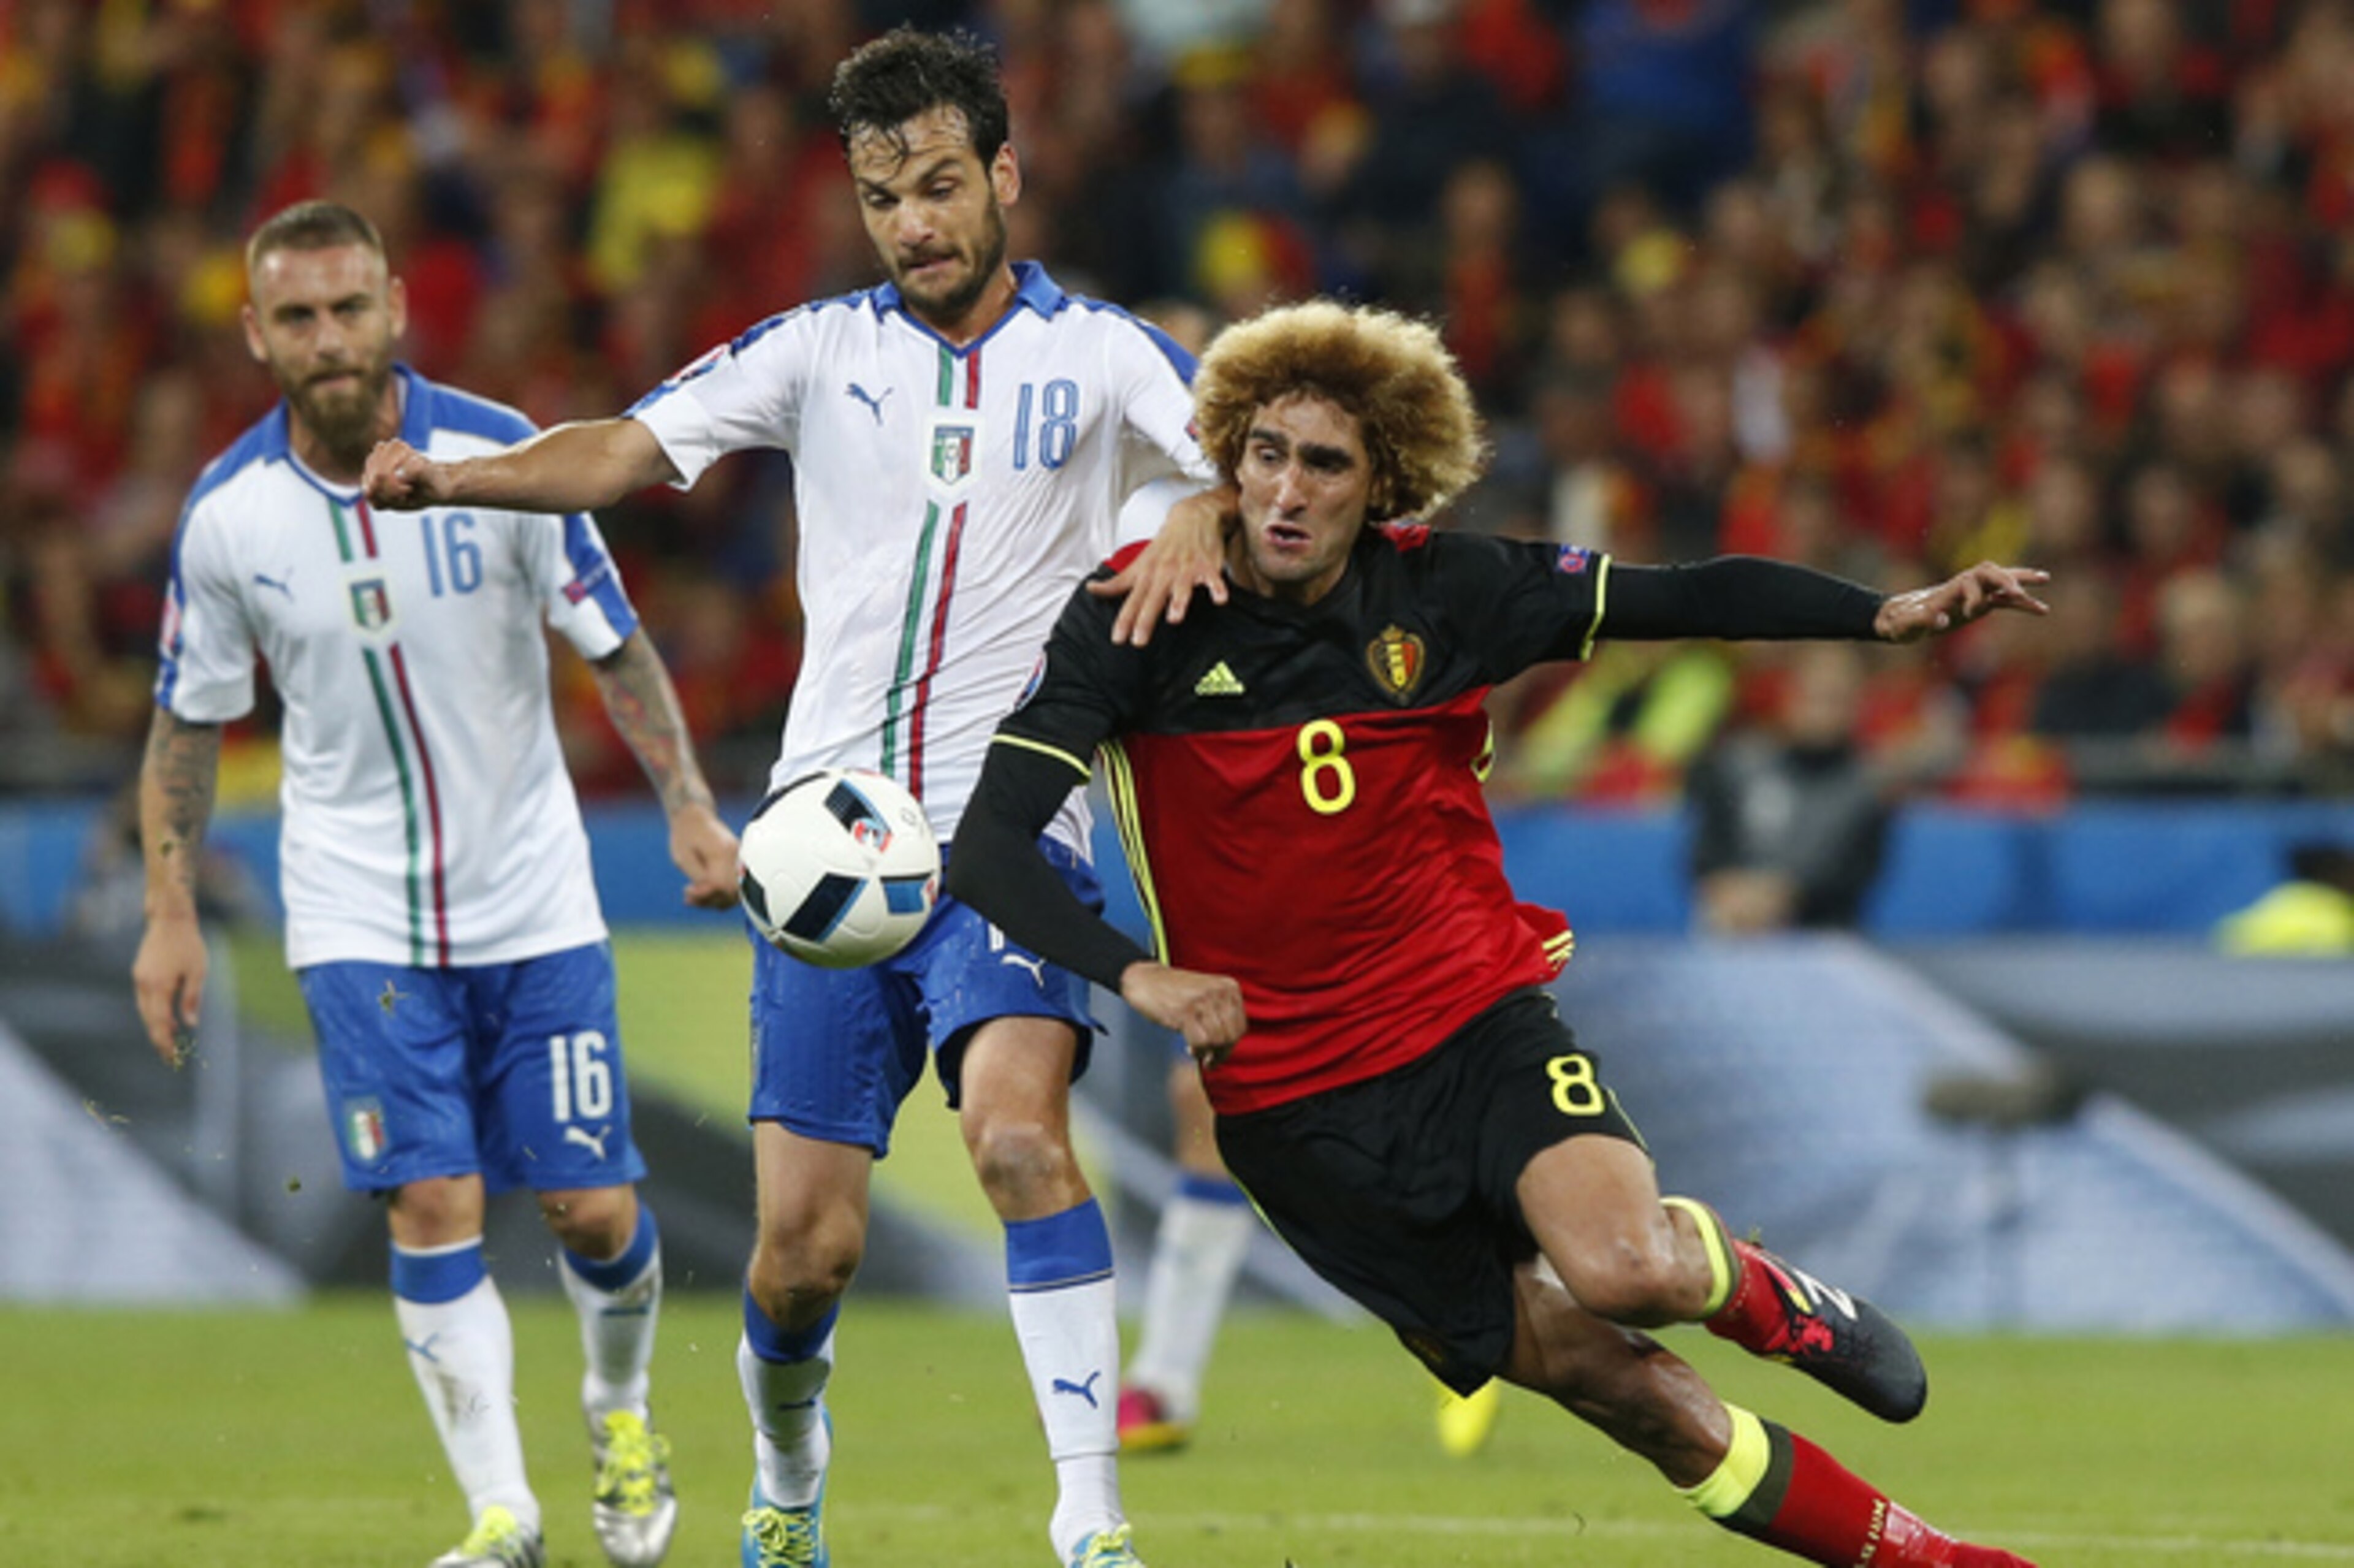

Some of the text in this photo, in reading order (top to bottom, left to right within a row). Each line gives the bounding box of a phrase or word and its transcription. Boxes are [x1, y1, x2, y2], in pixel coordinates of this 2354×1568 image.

[1013, 378, 1080, 470] 18
[420, 512, 483, 598] 16
[1297, 718, 1356, 815] 8
[549, 1030, 613, 1123] 16
[1545, 1052, 1606, 1116] 8
